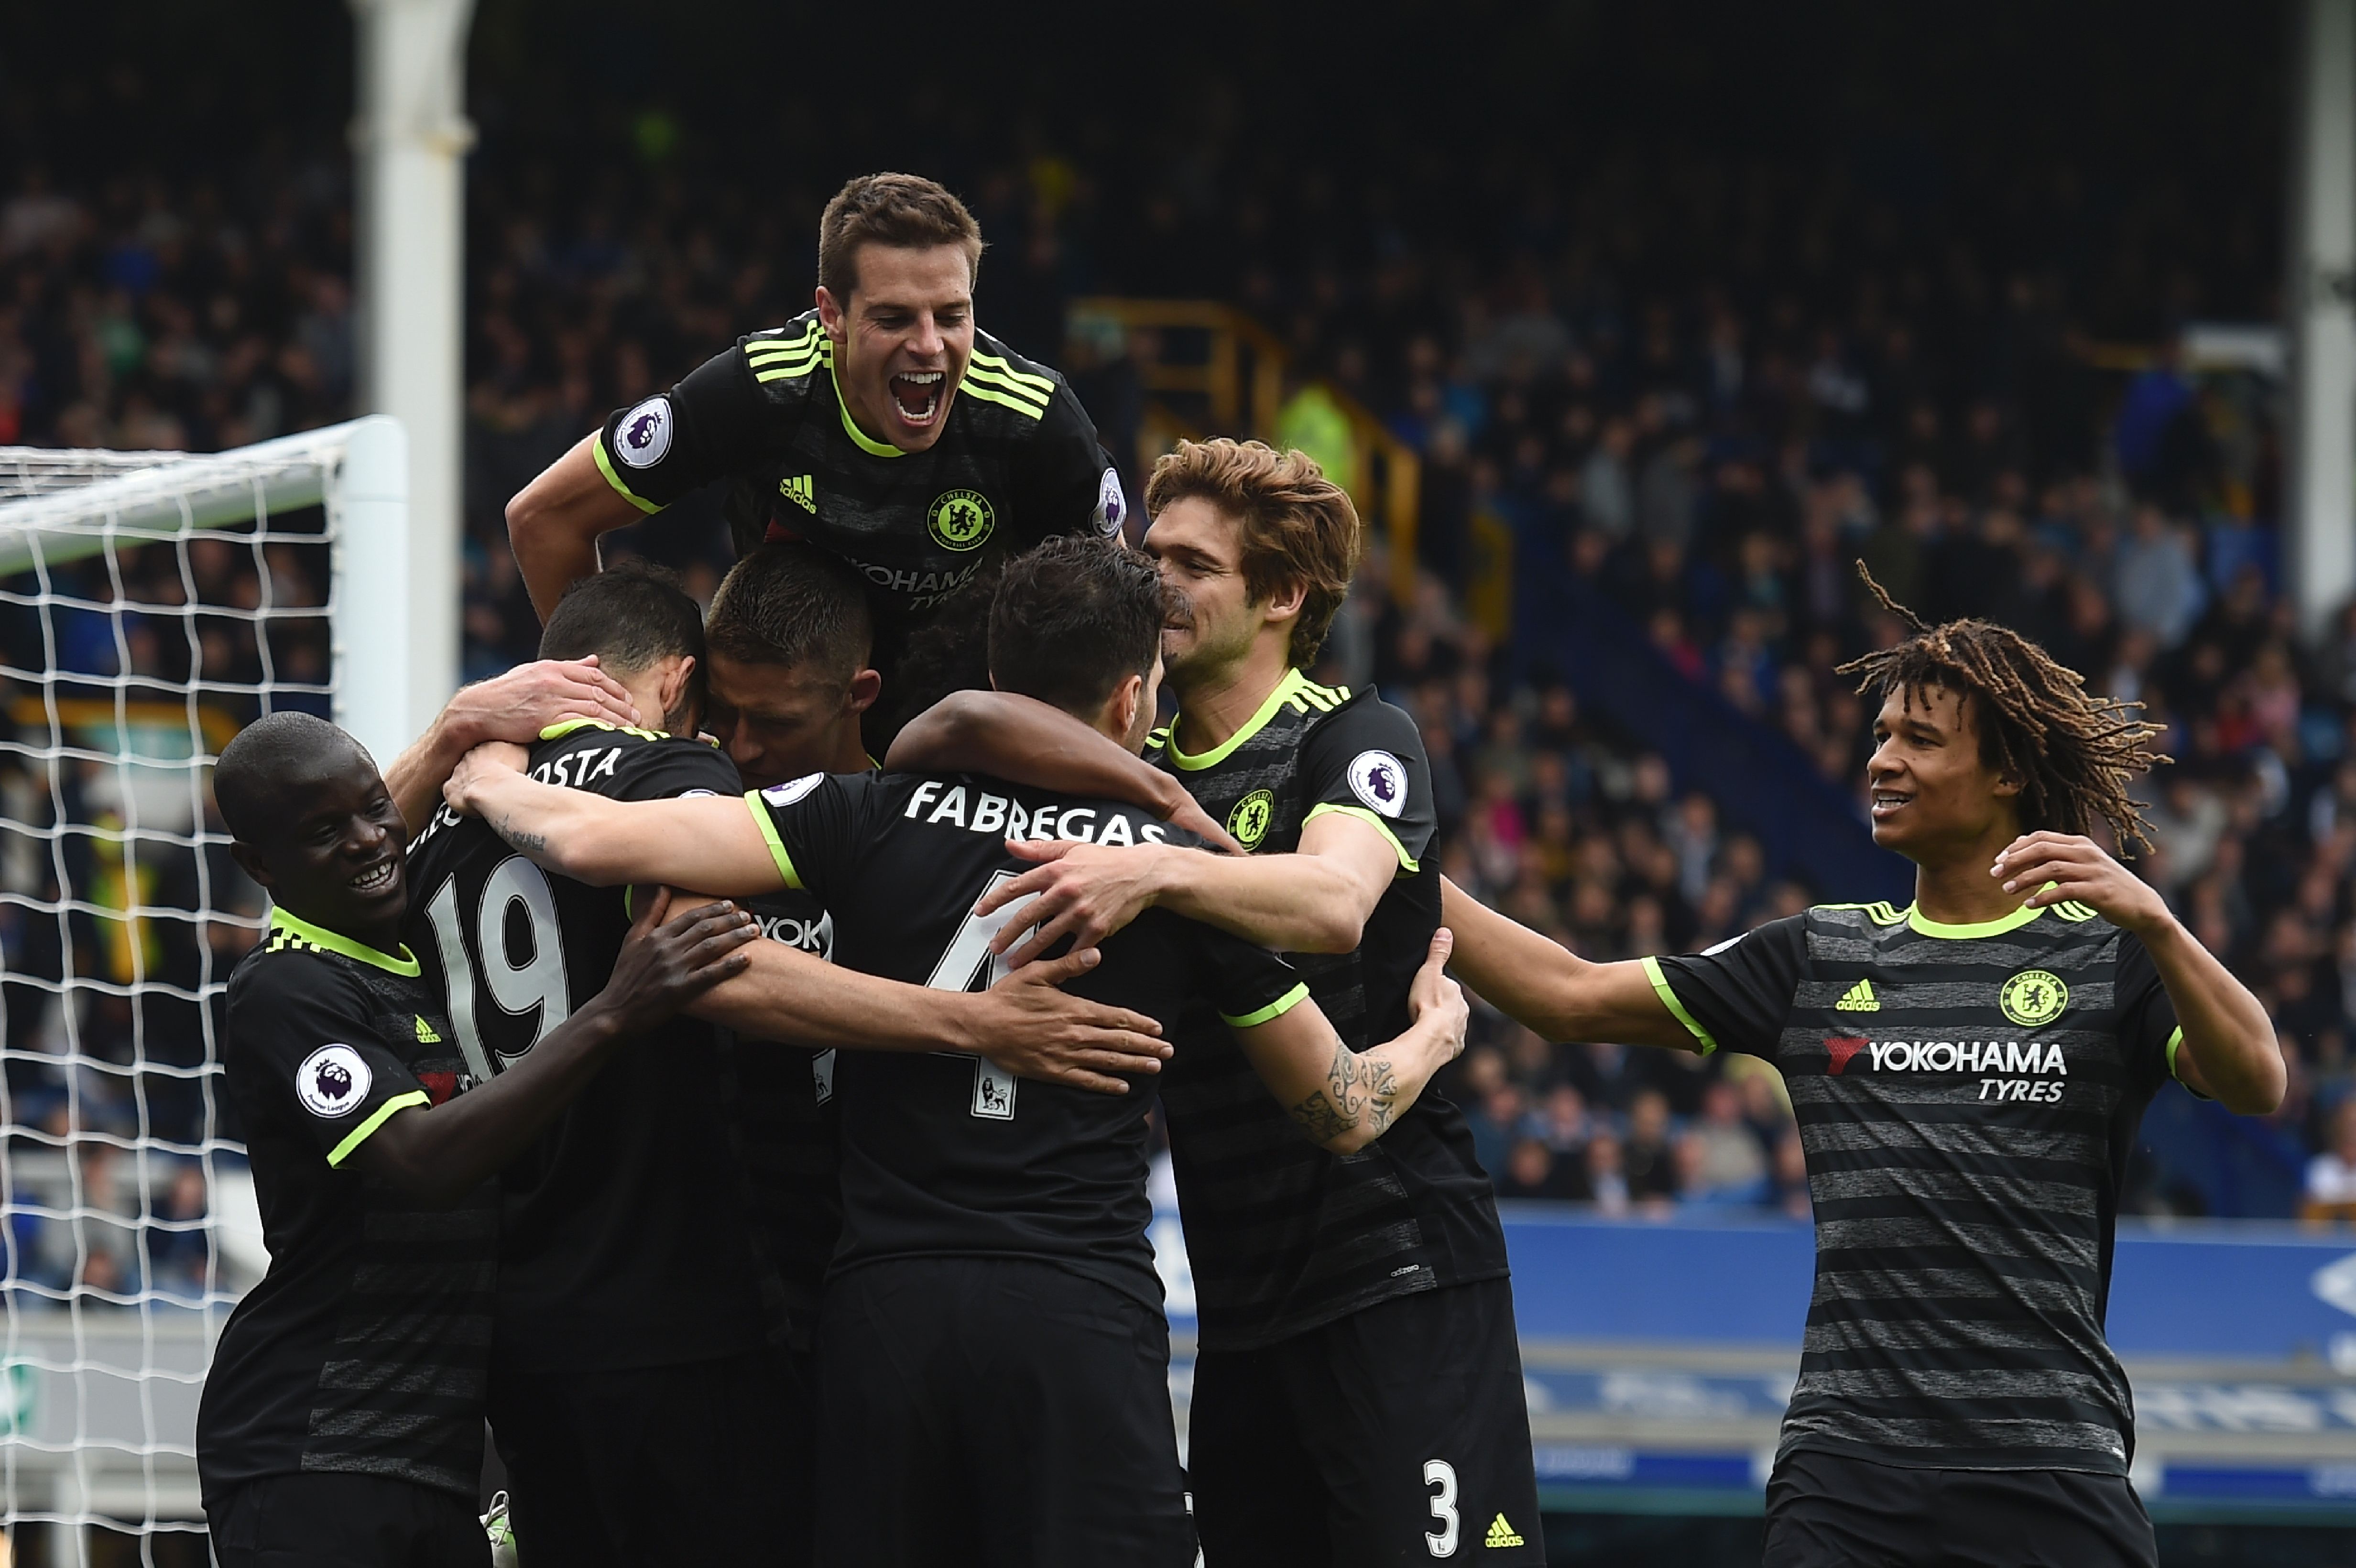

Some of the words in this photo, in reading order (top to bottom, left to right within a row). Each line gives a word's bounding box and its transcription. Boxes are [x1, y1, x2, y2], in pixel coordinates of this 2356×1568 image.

[779, 482, 817, 514] adidas
[940, 491, 982, 506] CHELSEA
[527, 747, 622, 786] OSTA
[904, 781, 1166, 847] FABREGAS
[424, 852, 571, 1079] 19
[2016, 973, 2057, 986] CHELSEA
[1835, 998, 1881, 1012] adidas
[1869, 1041, 2068, 1075] YOKOHAMA
[1978, 1078, 2066, 1102] TYRES
[1423, 1459, 1461, 1558] 3
[1485, 1535, 1524, 1547] adidas
